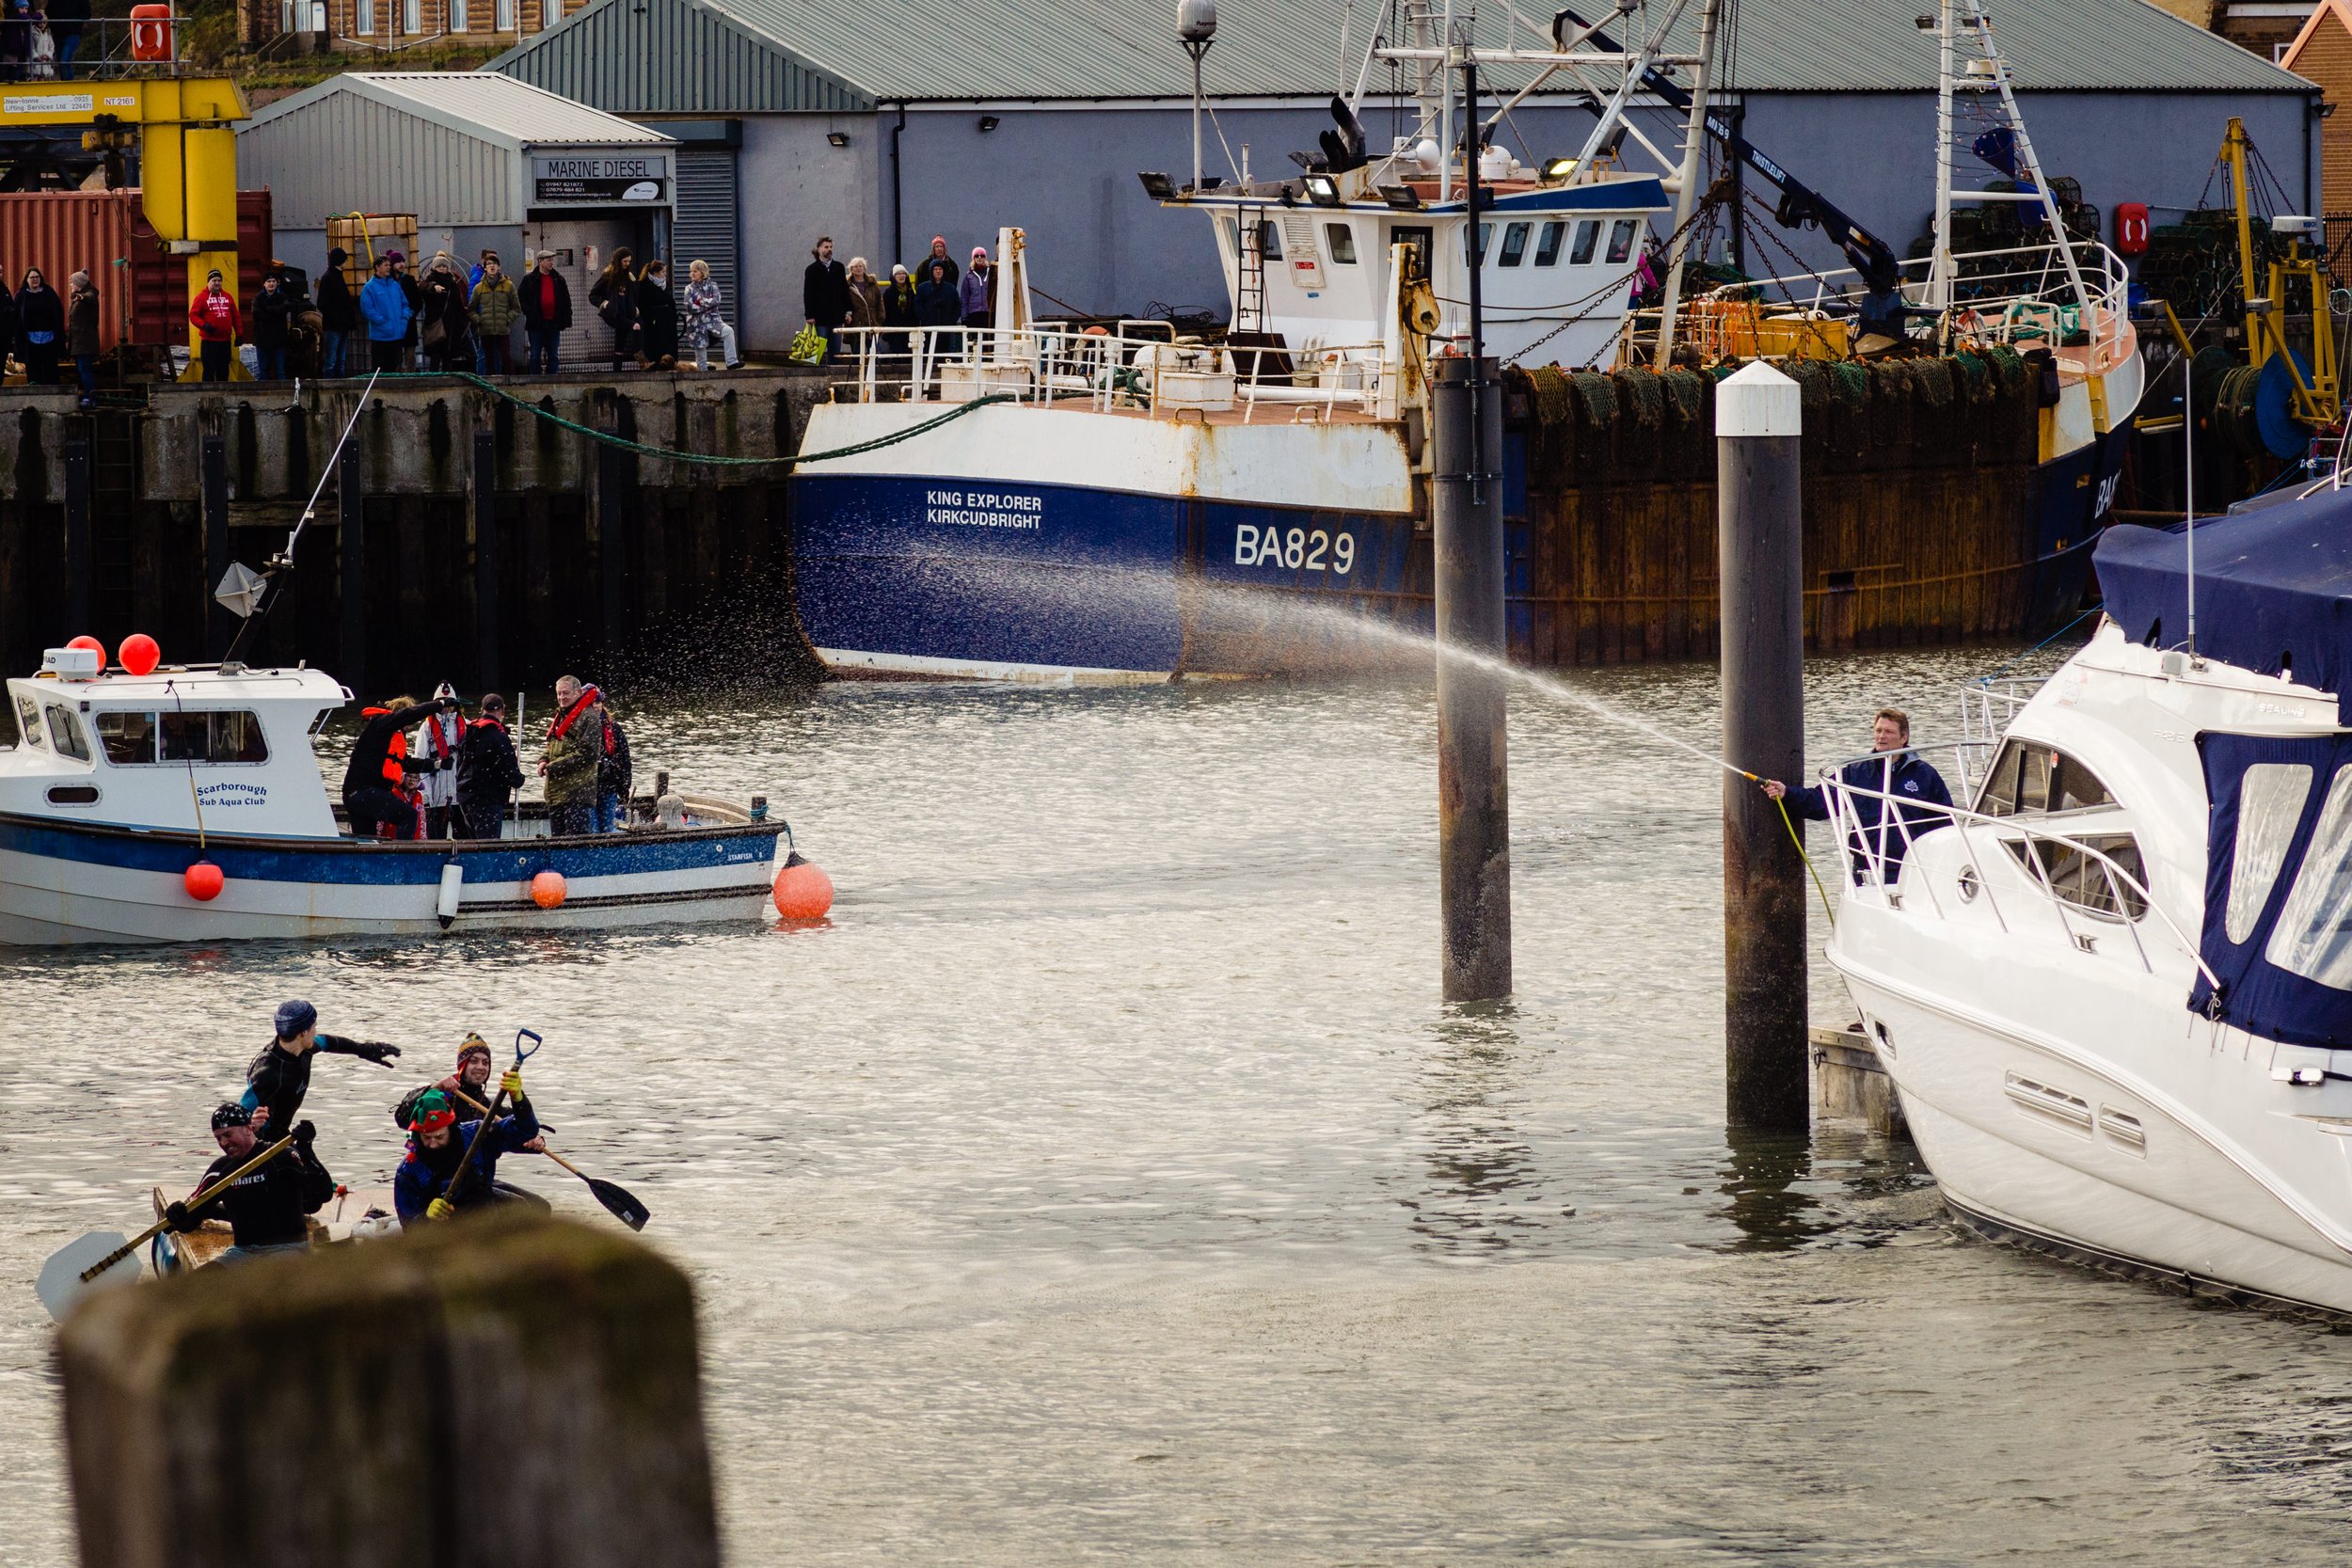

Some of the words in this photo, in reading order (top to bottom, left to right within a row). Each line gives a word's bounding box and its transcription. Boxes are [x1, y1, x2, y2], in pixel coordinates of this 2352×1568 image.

[548, 161, 600, 178] MARINE
[604, 160, 651, 177] DIESEL
[1751, 149, 1787, 183] THISTLELIFT
[927, 490, 961, 506] KING
[967, 493, 1041, 512] EXPLORER
[927, 509, 1041, 530] KIRKCUDBRIGHT
[1235, 524, 1355, 575] BA829
[2259, 703, 2305, 717] SEALINE
[197, 783, 267, 797] Scarborough
[199, 798, 217, 806] Sub
[218, 798, 242, 807] Aqua
[727, 852, 754, 862] STARFISH
